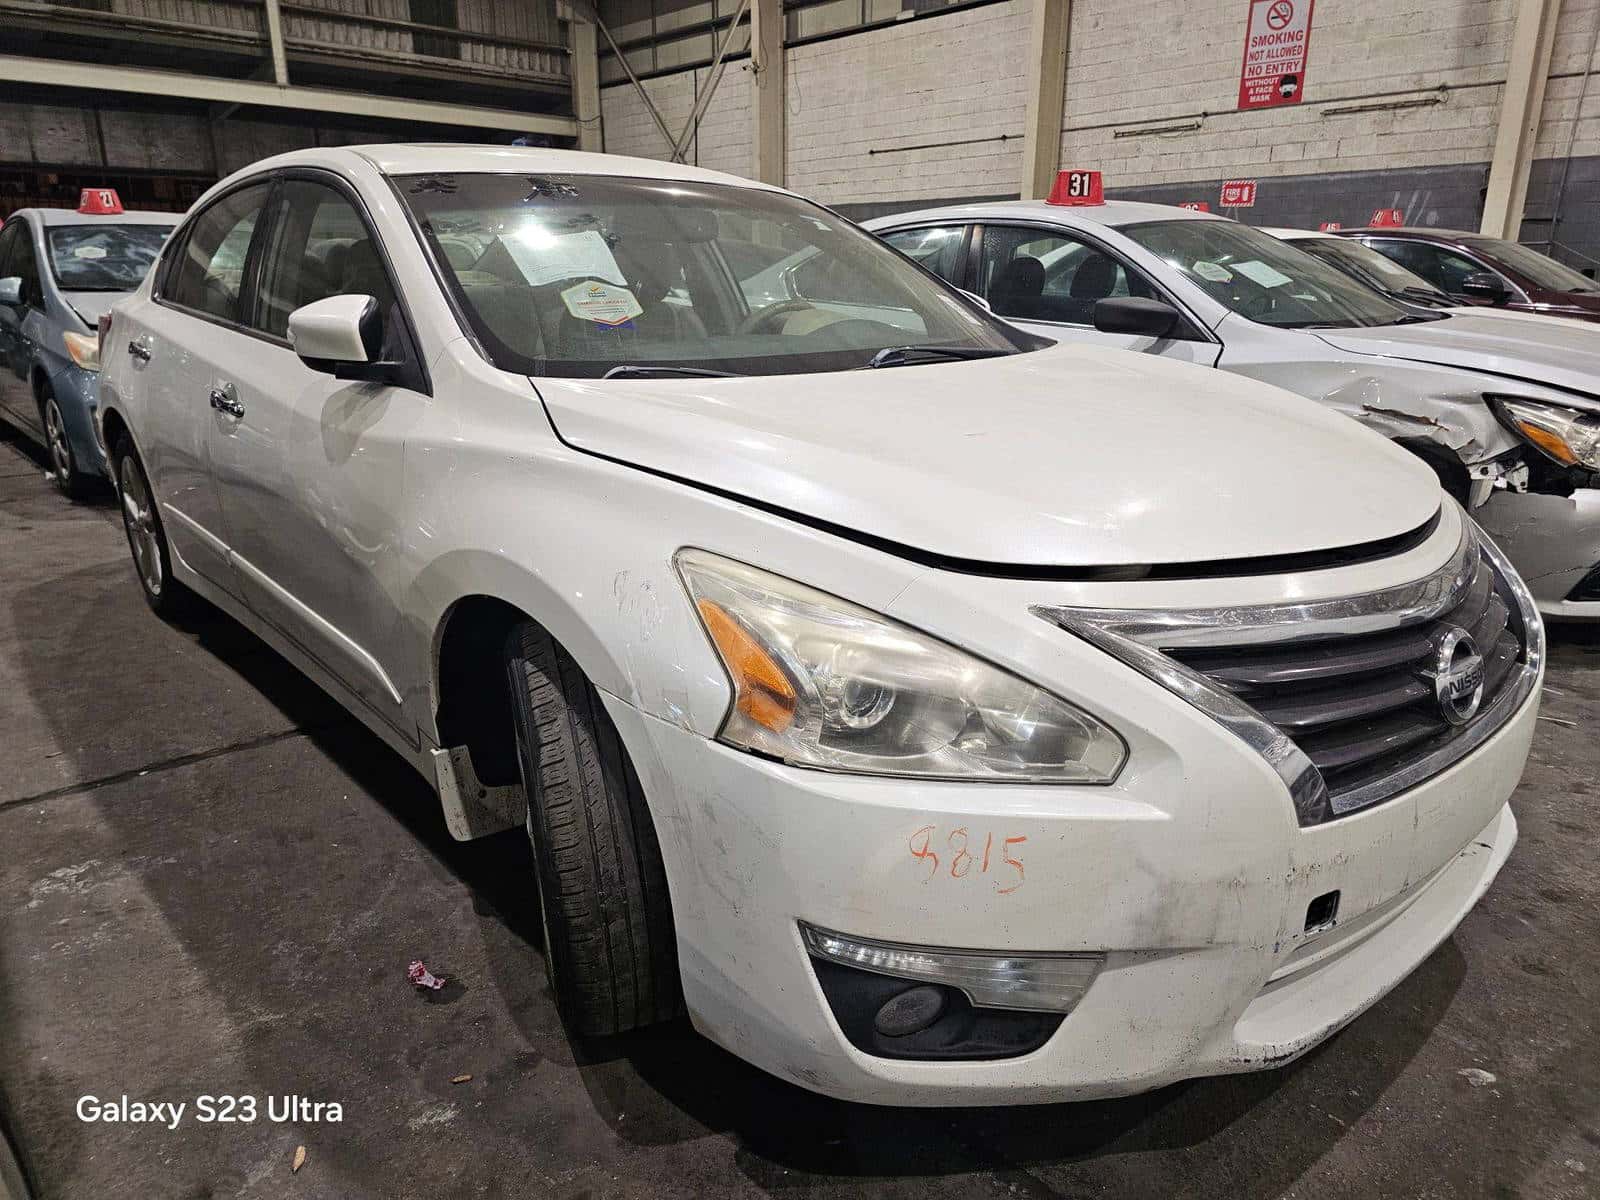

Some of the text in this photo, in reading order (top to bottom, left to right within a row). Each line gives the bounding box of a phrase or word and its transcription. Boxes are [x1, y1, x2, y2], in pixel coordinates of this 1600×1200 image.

[1251, 30, 1304, 48] SMOKING
[1249, 45, 1303, 62] NOT ALLOWED
[1247, 60, 1301, 77] NO ENTRY
[1245, 76, 1280, 88] WITHOUT
[1255, 85, 1274, 95] FACE
[1248, 94, 1271, 103] MASK
[1070, 173, 1090, 197] 31
